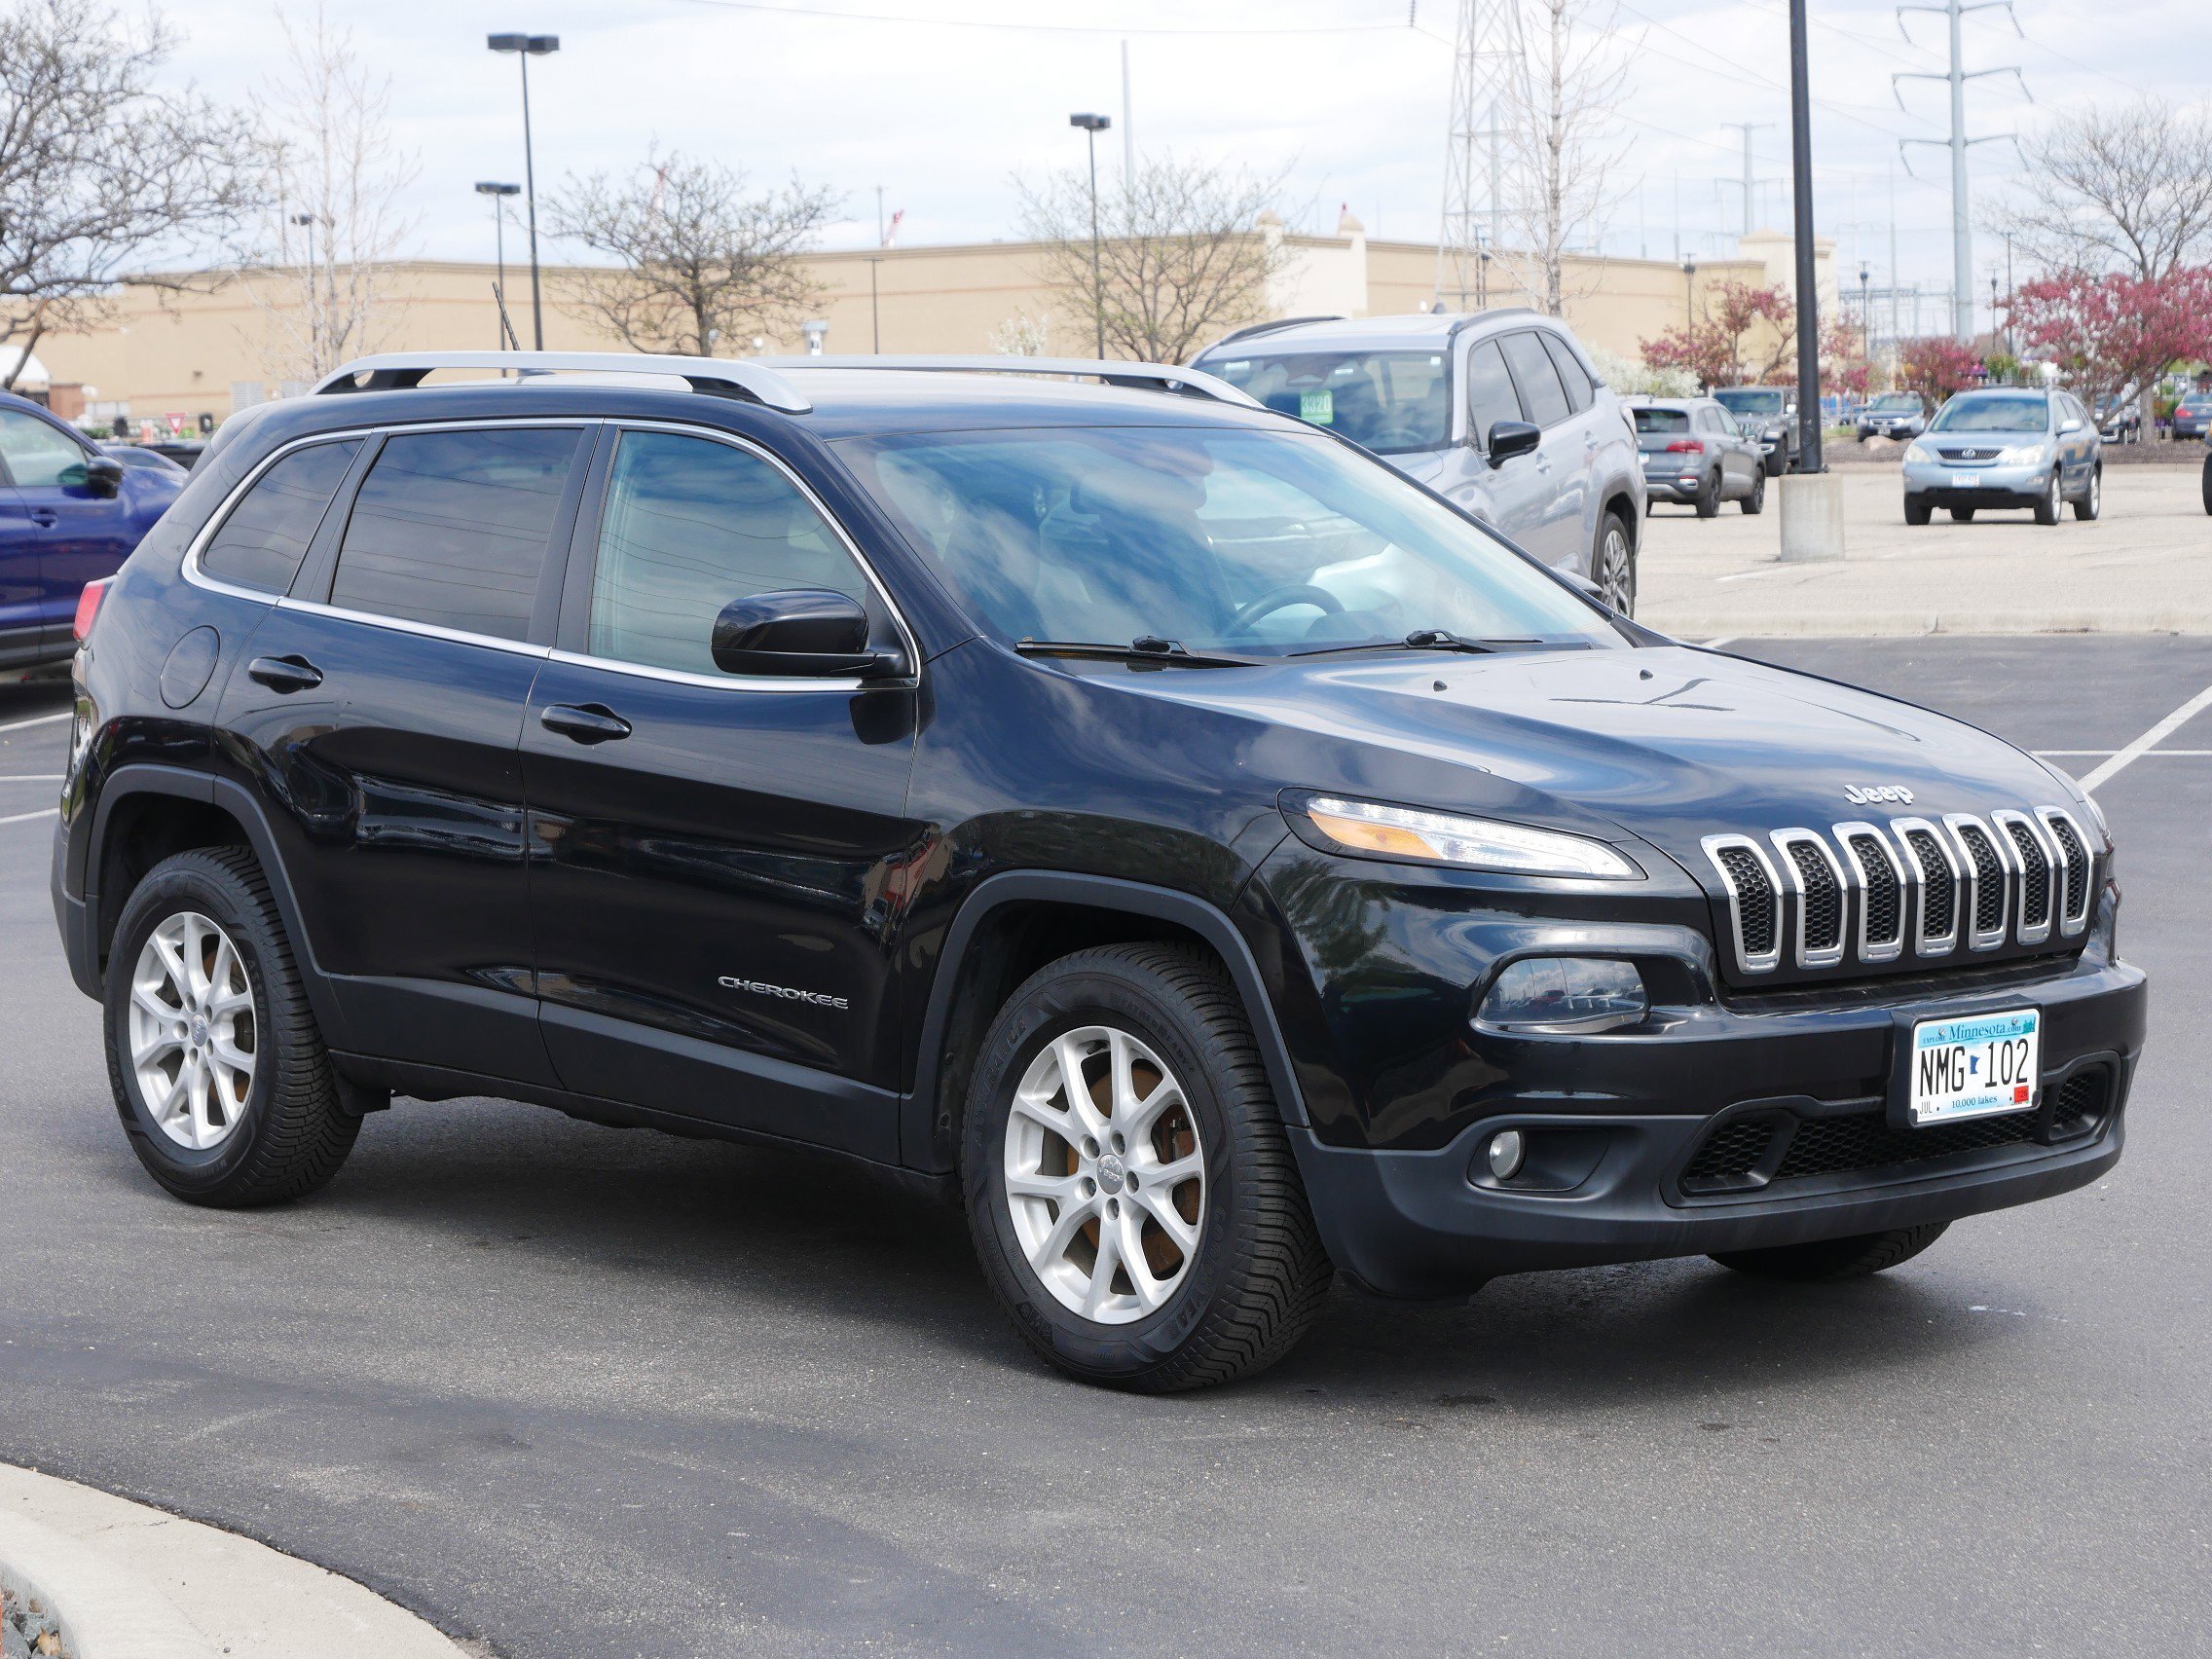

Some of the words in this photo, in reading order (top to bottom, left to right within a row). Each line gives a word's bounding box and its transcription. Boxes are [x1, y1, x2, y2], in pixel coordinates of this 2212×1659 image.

[1302, 395, 1331, 413] 3320
[1845, 785, 1914, 805] Jeep
[718, 976, 849, 1010] CHEROKEE
[1920, 1046, 1965, 1096] NMG
[1985, 1039, 2028, 1088] 102
[1920, 1101, 1932, 1114] JUL
[1952, 1096, 1976, 1109] 10,000
[1977, 1094, 1998, 1105] lakes
